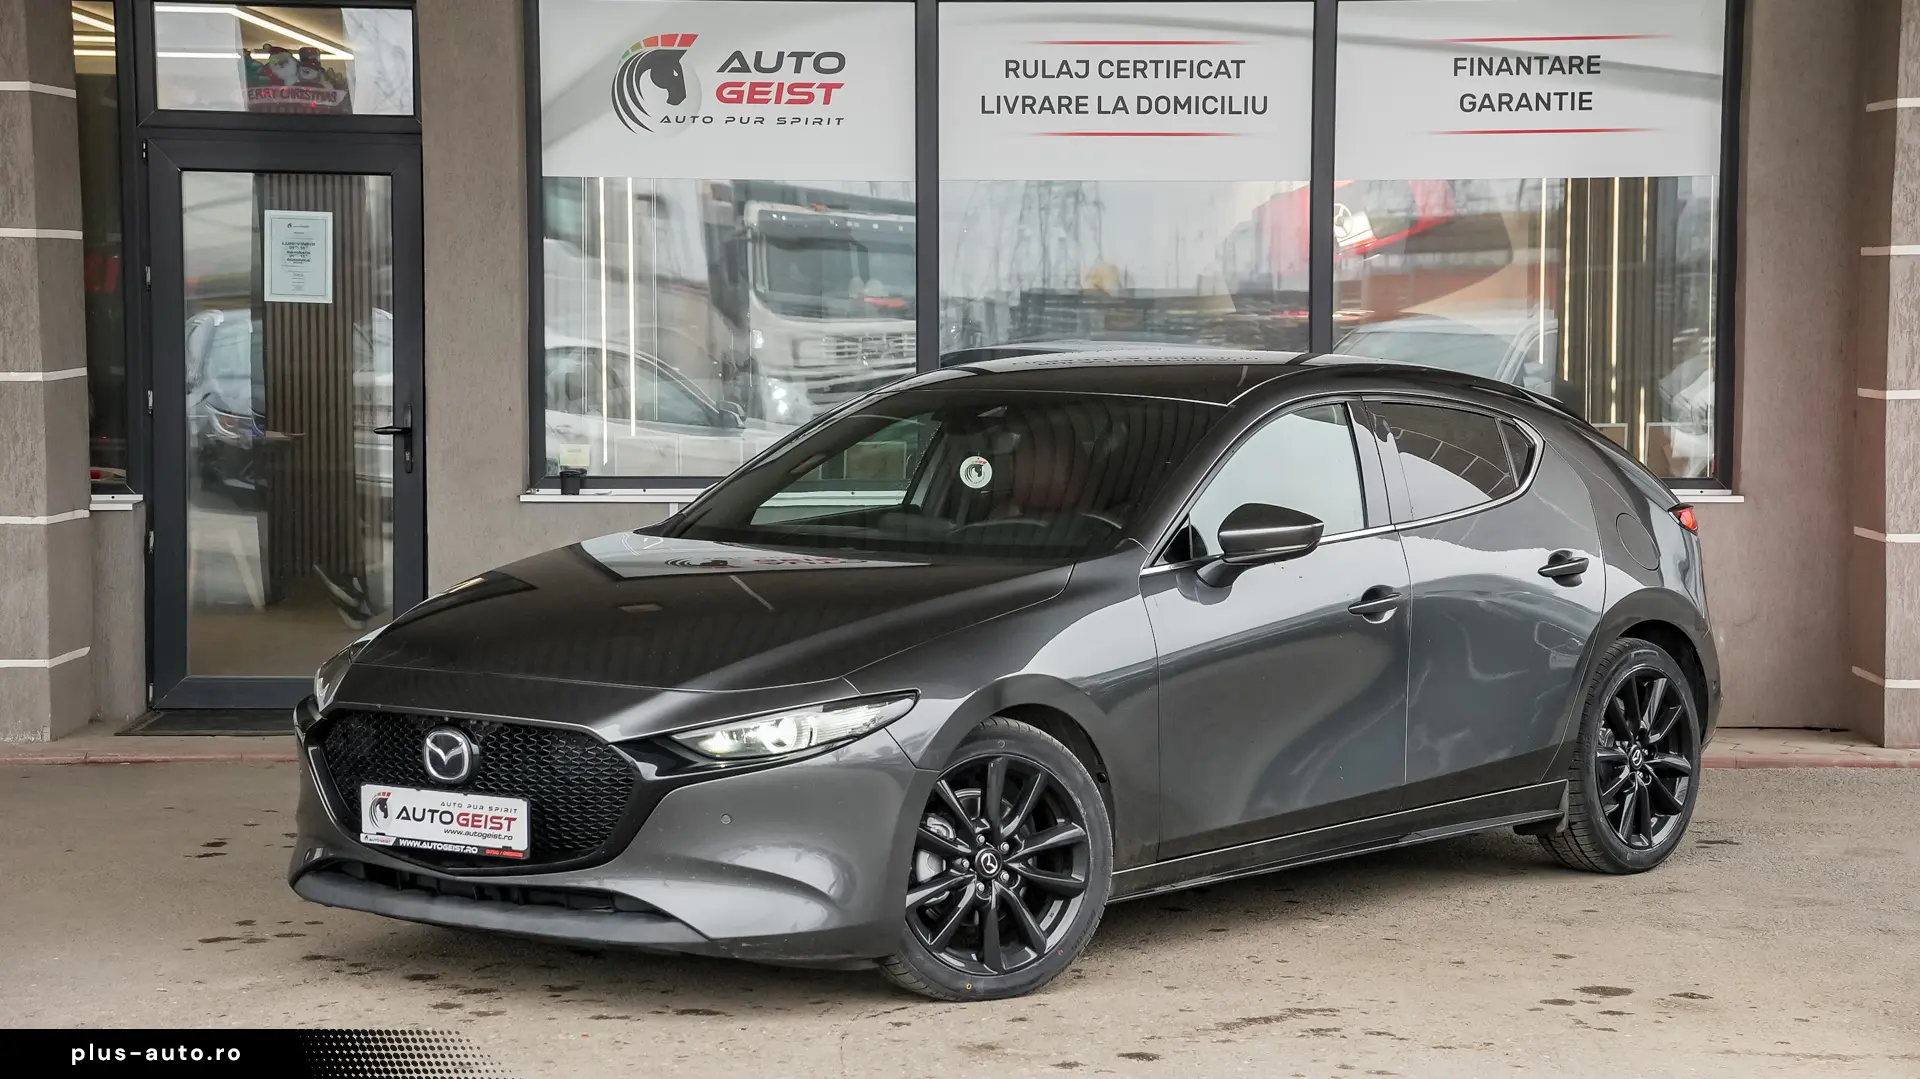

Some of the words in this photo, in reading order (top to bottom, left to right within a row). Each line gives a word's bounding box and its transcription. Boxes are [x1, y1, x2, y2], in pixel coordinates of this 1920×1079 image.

[716, 50, 846, 74] AUTO
[1004, 59, 1090, 79] RULAJ
[1098, 59, 1246, 79] CERTIFICAT
[1453, 55, 1601, 77] FINANTARE
[247, 87, 276, 100] ERRY
[280, 88, 338, 102] CHRISTMAS
[716, 82, 845, 105] GEIST
[1459, 91, 1593, 113] GARANTIE
[981, 95, 1089, 115] LIVRARE
[1097, 95, 1130, 115] LA
[1136, 95, 1268, 115] DOMICILIU
[659, 115, 713, 124] AUTO
[725, 116, 764, 125] PUR
[777, 116, 845, 126] SPIRIT
[440, 801, 463, 809] AUTO
[467, 803, 484, 811] PUR
[488, 805, 518, 814] SPIRIT
[444, 828, 513, 841] www.autogeist.ro
[399, 838, 479, 854] WWW.AUTOGEIST.RO
